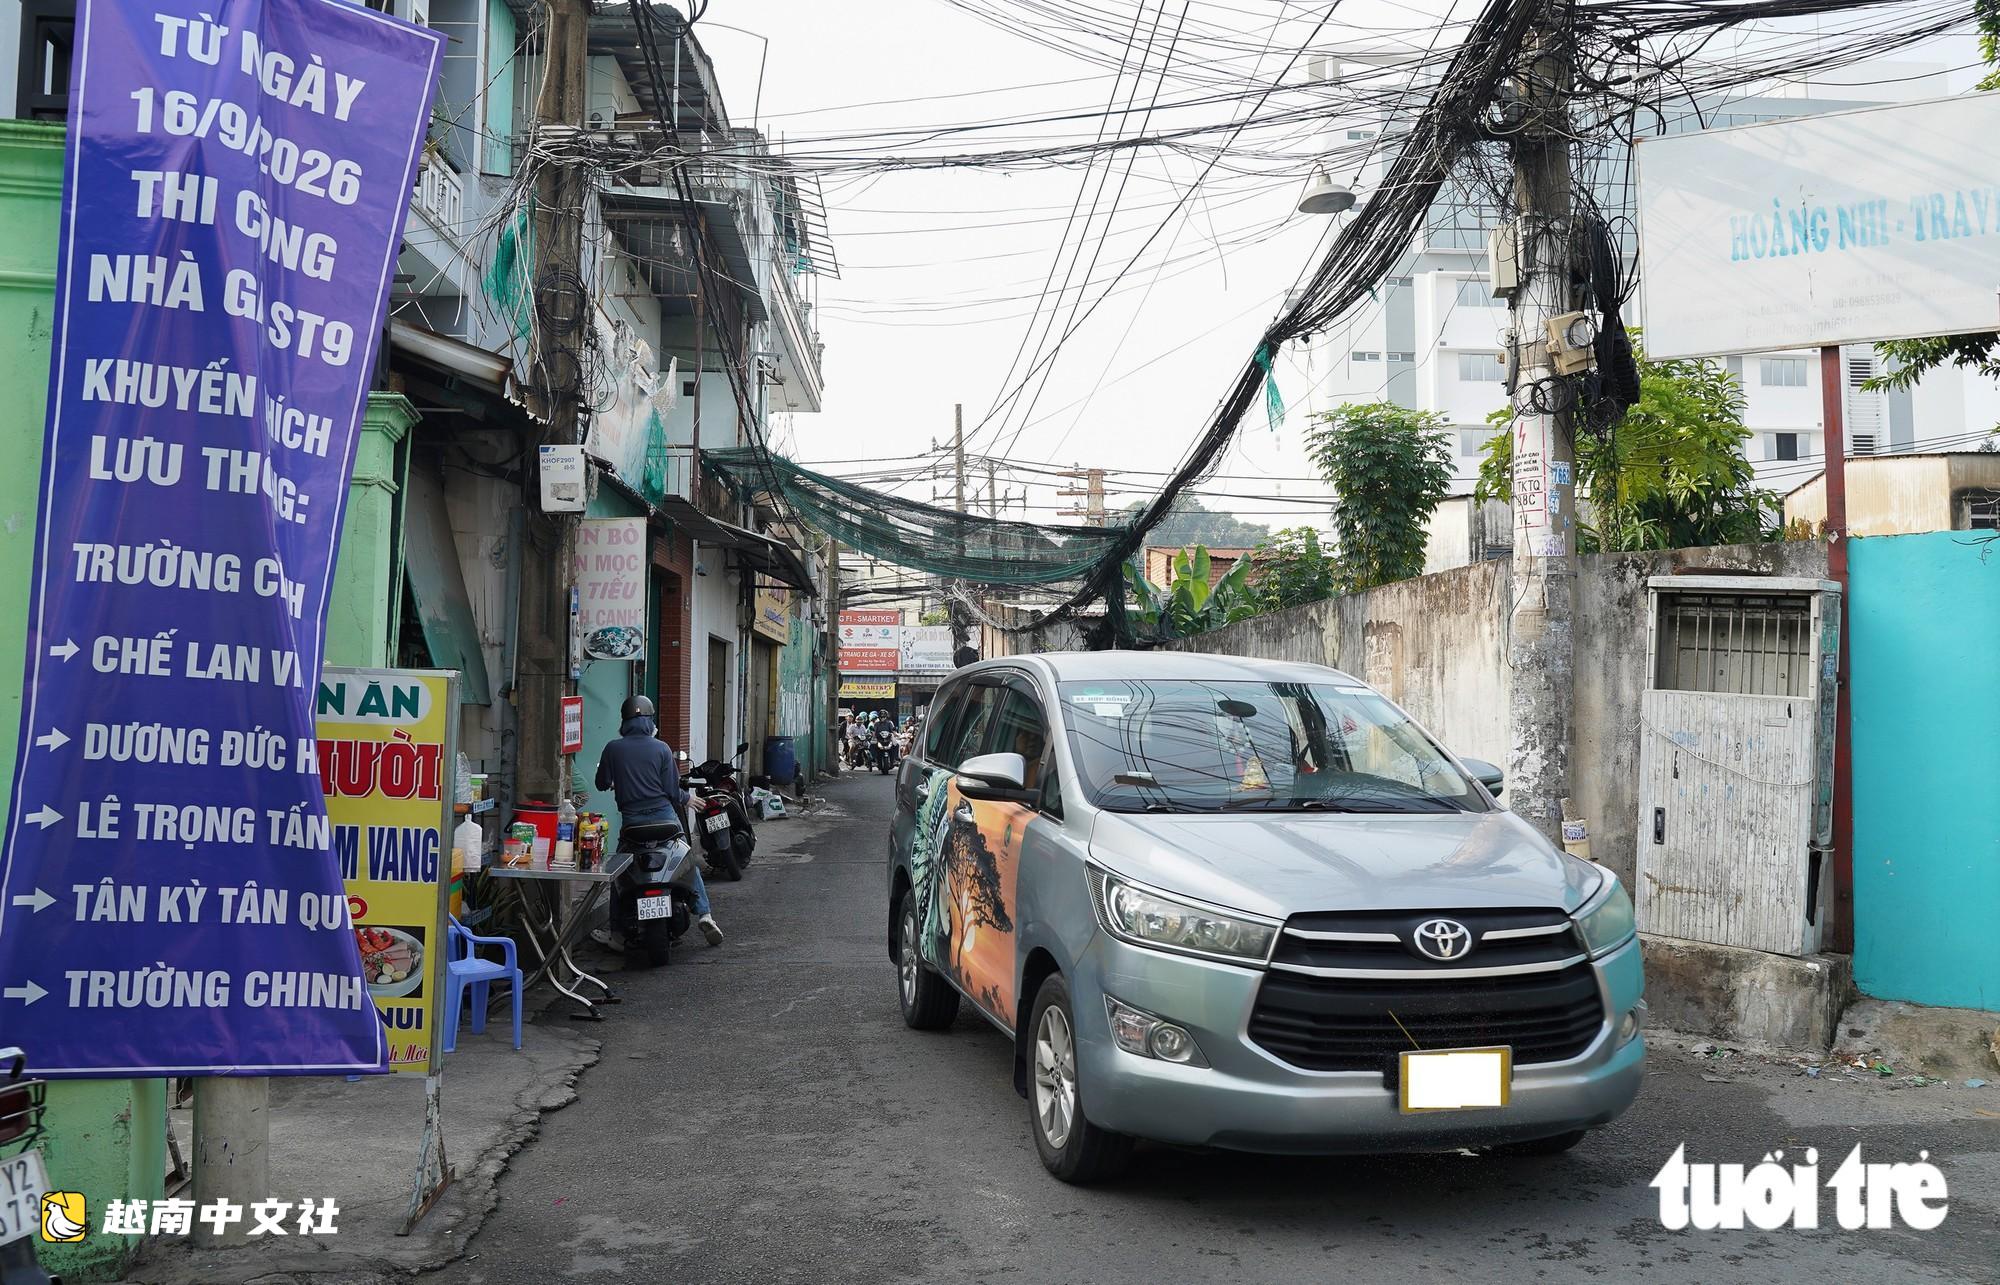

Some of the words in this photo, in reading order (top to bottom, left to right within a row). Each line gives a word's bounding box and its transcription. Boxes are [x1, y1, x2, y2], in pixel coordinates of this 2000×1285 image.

[154, 13, 230, 66] TỪ
[241, 31, 366, 122] NGÀY
[131, 87, 362, 206] 16/9/2026
[131, 170, 218, 225] THI
[1730, 197, 1830, 262] HOÀNG
[1837, 198, 1889, 251] NHI
[88, 250, 205, 312] NHÀ
[82, 356, 257, 417] KHUYẾN
[265, 384, 333, 457] HÍCH
[89, 434, 183, 486] LƯU
[607, 522, 639, 545] BÒ
[73, 539, 240, 593] TRƯỜNG
[596, 554, 638, 575] MỌC
[596, 608, 638, 626] CANH
[857, 615, 895, 623] SMARTKEY
[92, 629, 177, 677] CHẾ
[185, 642, 261, 683] LAN
[356, 681, 420, 718] ĂN
[84, 724, 209, 765] DƯƠNG
[221, 725, 286, 772] ĐỨC
[77, 795, 120, 838] LÊ
[134, 803, 255, 849] TRỌNG
[267, 801, 330, 850] TẤN
[368, 826, 440, 883] VANG
[72, 877, 146, 922] TÂN
[157, 879, 207, 923] KỲ
[218, 881, 289, 925] TÂN
[65, 962, 230, 1009] TRƯỜNG
[243, 974, 363, 1010] CHINH
